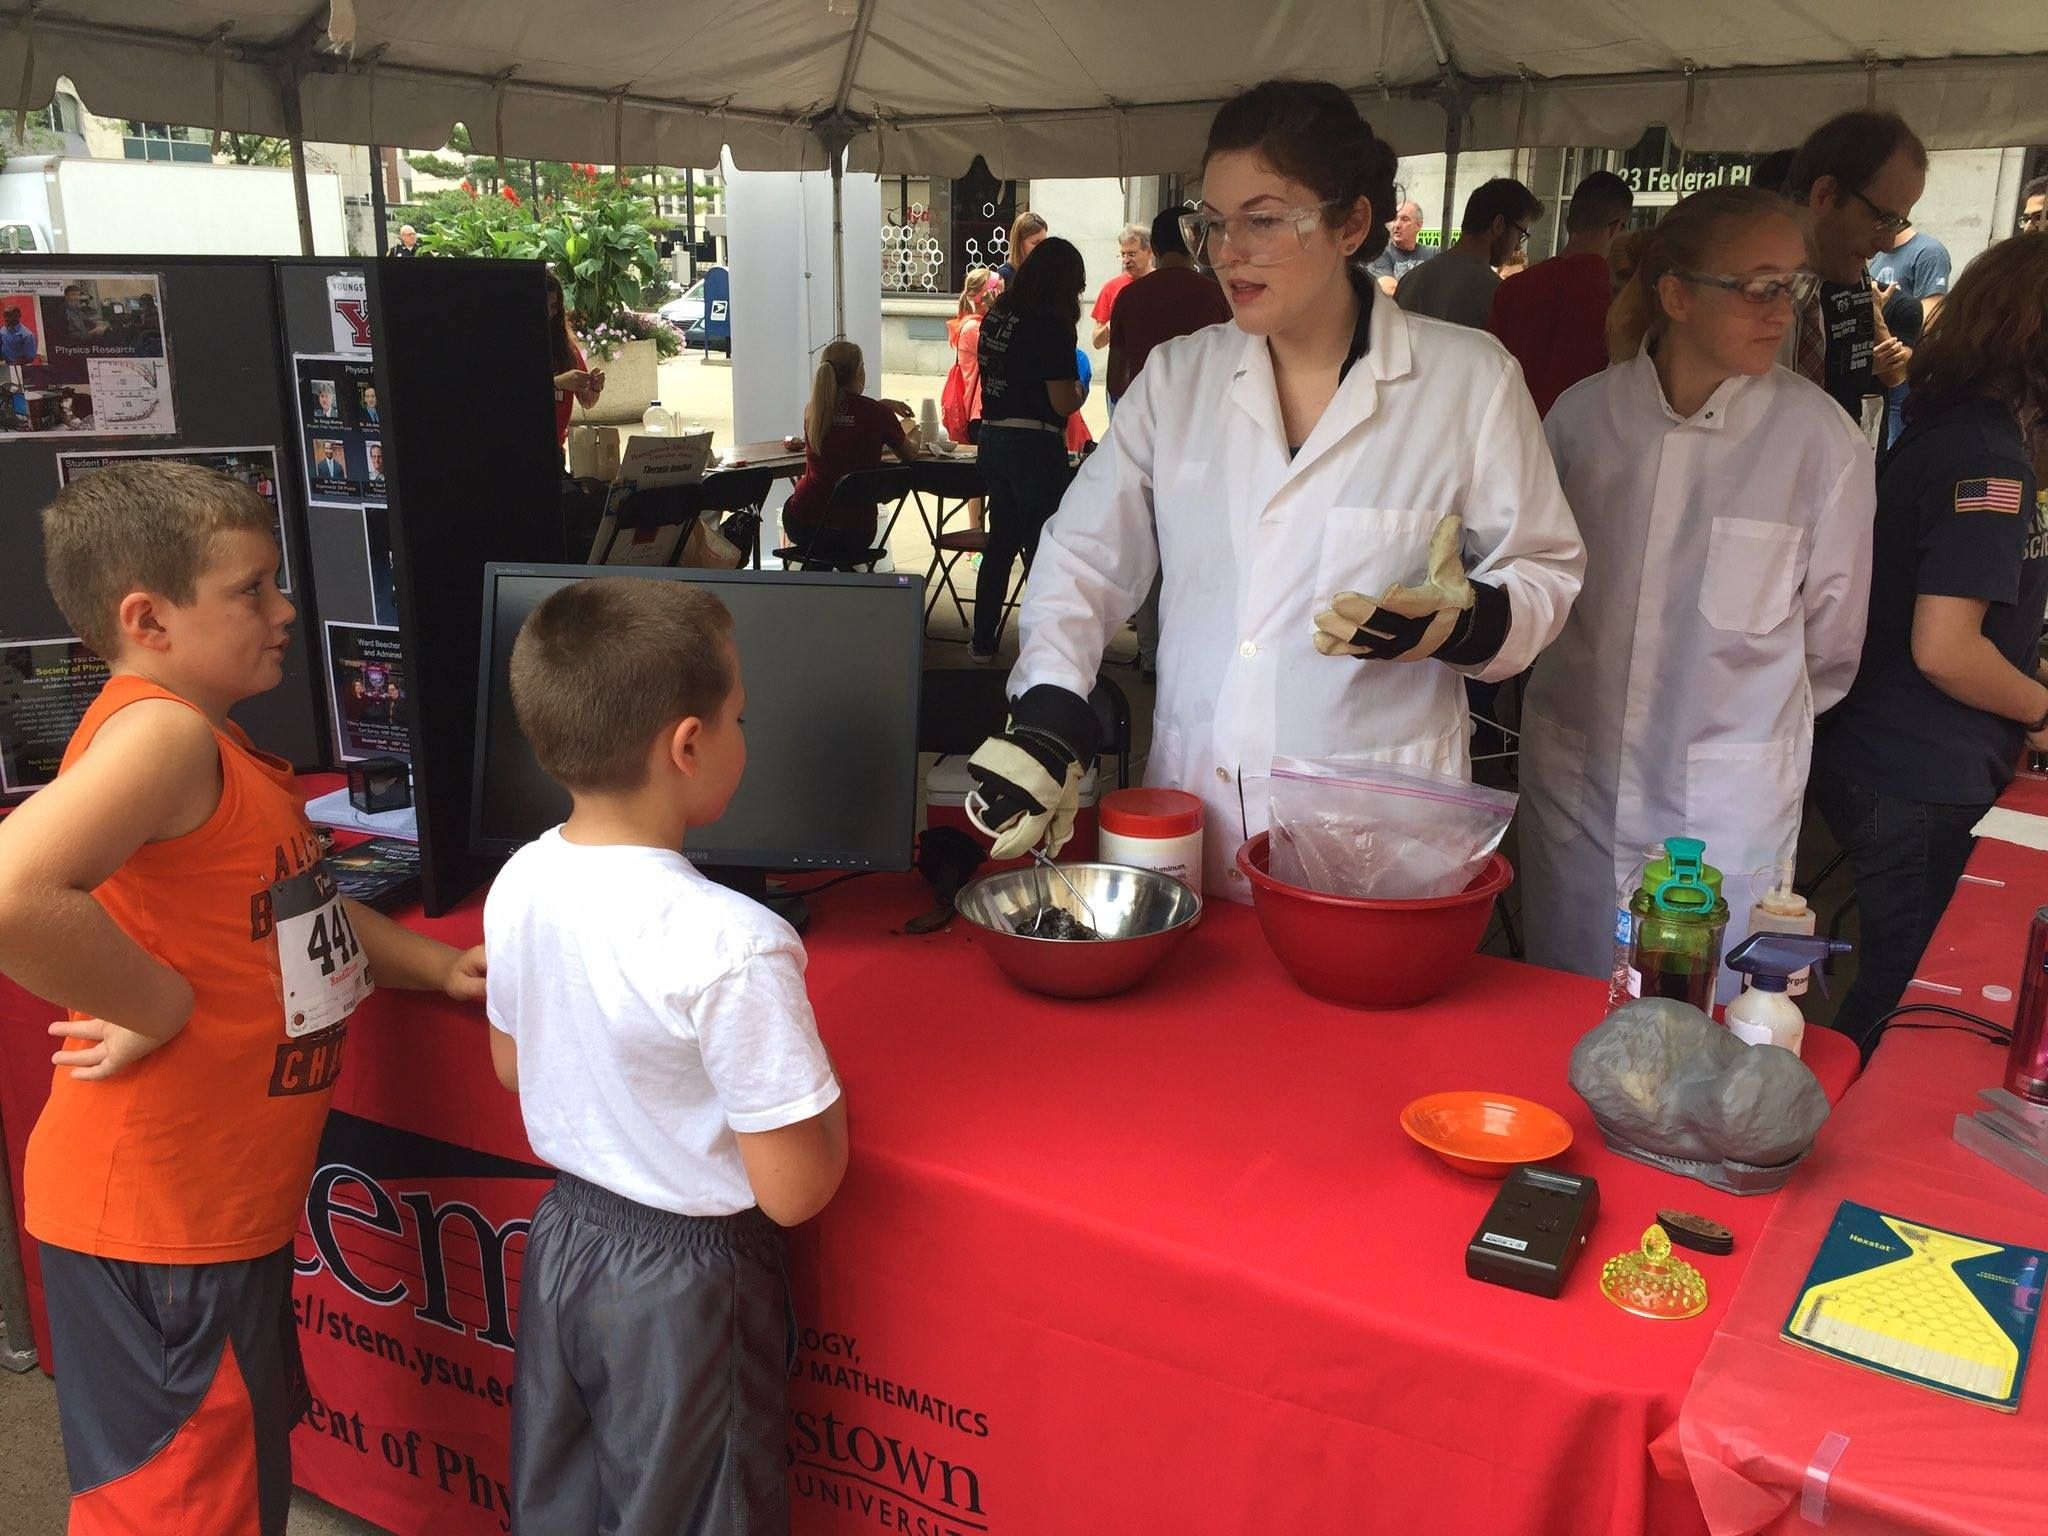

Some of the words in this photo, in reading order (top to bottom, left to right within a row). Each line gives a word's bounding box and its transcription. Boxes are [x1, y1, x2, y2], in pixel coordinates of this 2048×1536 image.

[1647, 166, 1724, 192] Federal
[332, 282, 365, 292] YOUNGS
[55, 345, 90, 355] Physics
[92, 345, 135, 354] Research
[345, 365, 369, 375] Physics
[65, 458, 100, 468] Student
[358, 638, 375, 648] Ward
[363, 649, 376, 657] and
[35, 667, 69, 676] Society
[71, 665, 82, 673] of
[294, 1163, 534, 1352] em
[799, 1327, 861, 1364] OGY,
[811, 1361, 990, 1437] MATHEMATICS
[381, 1430, 422, 1479] of
[787, 1408, 987, 1516] stown
[794, 1472, 963, 1536] UNIVERSI
